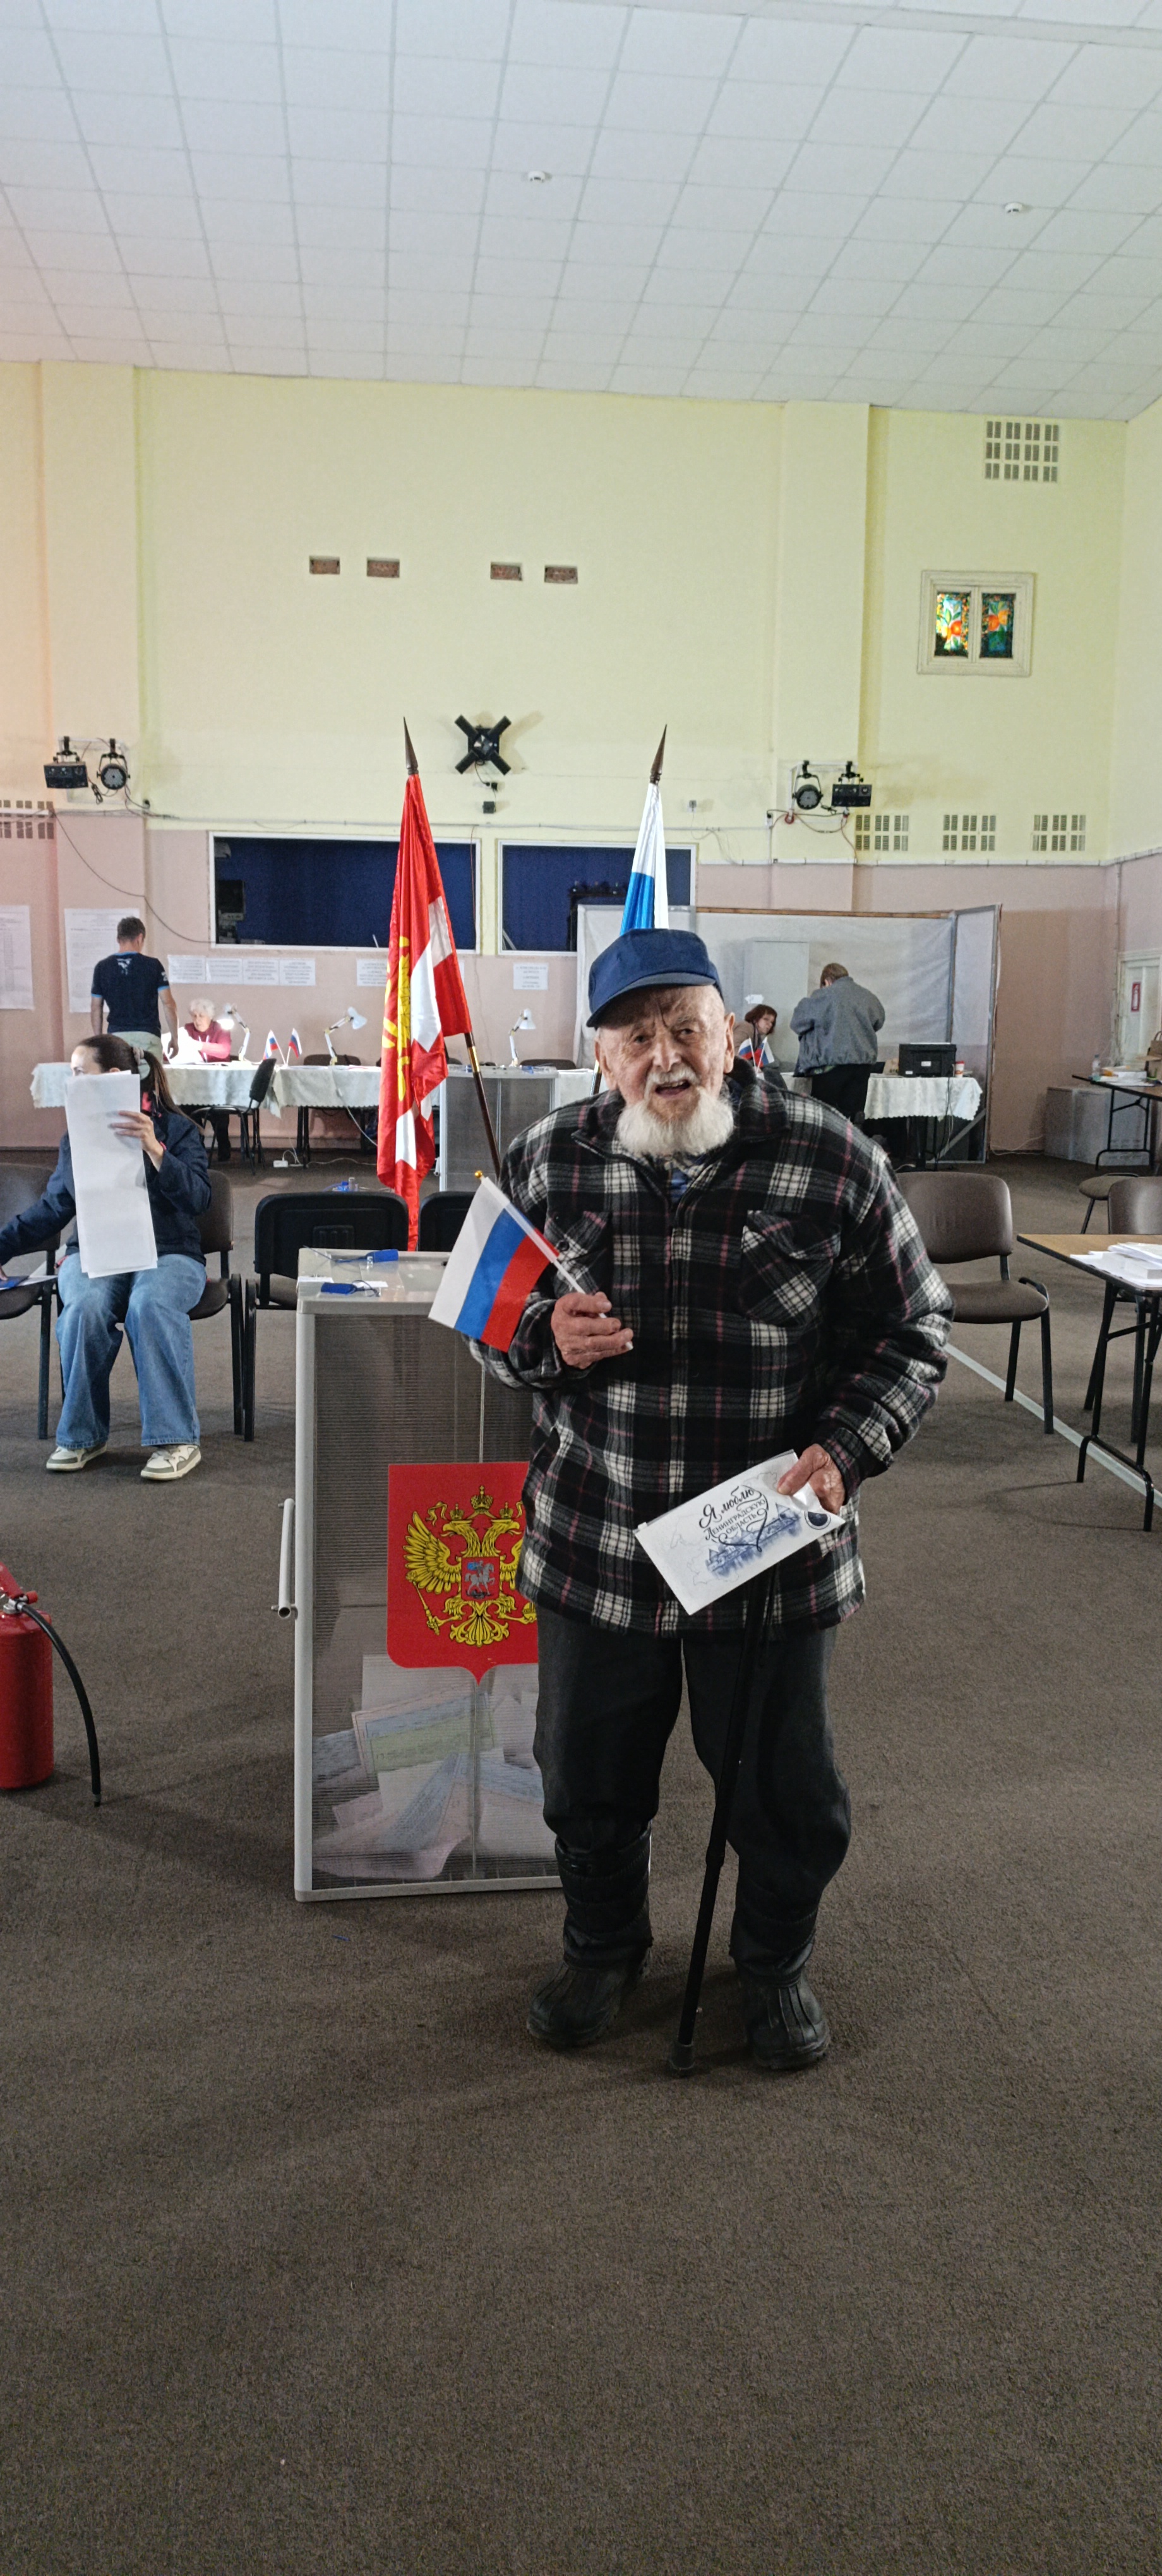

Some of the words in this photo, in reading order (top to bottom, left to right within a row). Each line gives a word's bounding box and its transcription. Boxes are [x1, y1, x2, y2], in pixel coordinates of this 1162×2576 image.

[698, 1503, 722, 1529] Я
[721, 1486, 755, 1513] люблю
[704, 1499, 765, 1541] ЛЕНИНГРАДСКУЮ
[726, 1513, 757, 1534] ОБЛАСТЬ
